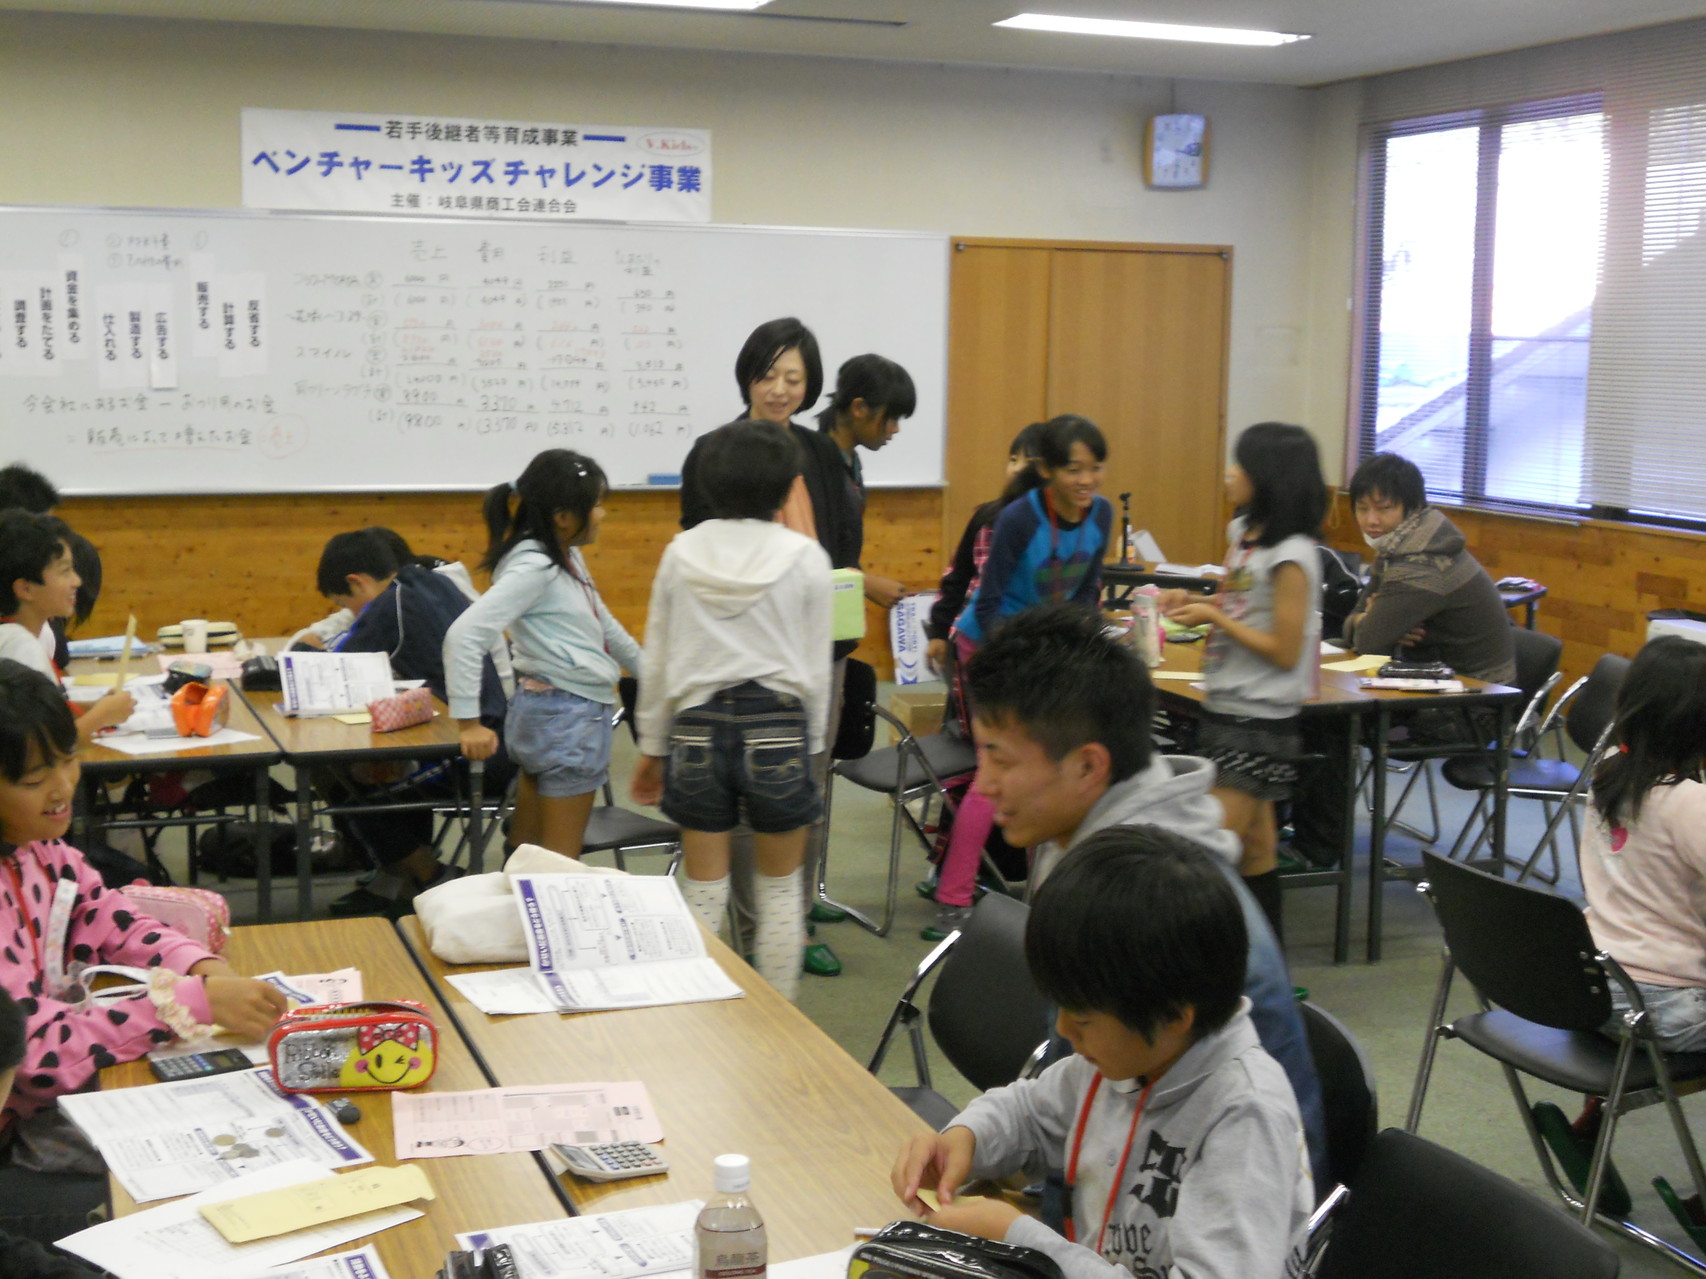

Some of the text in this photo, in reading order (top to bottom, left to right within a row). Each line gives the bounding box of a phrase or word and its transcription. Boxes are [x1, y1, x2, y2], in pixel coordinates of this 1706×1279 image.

[385, 120, 578, 147] 若手後継者等育成事業
[252, 150, 702, 193] ベンチャーキッズチャレンジ事業
[896, 603, 907, 653] SAGAWA
